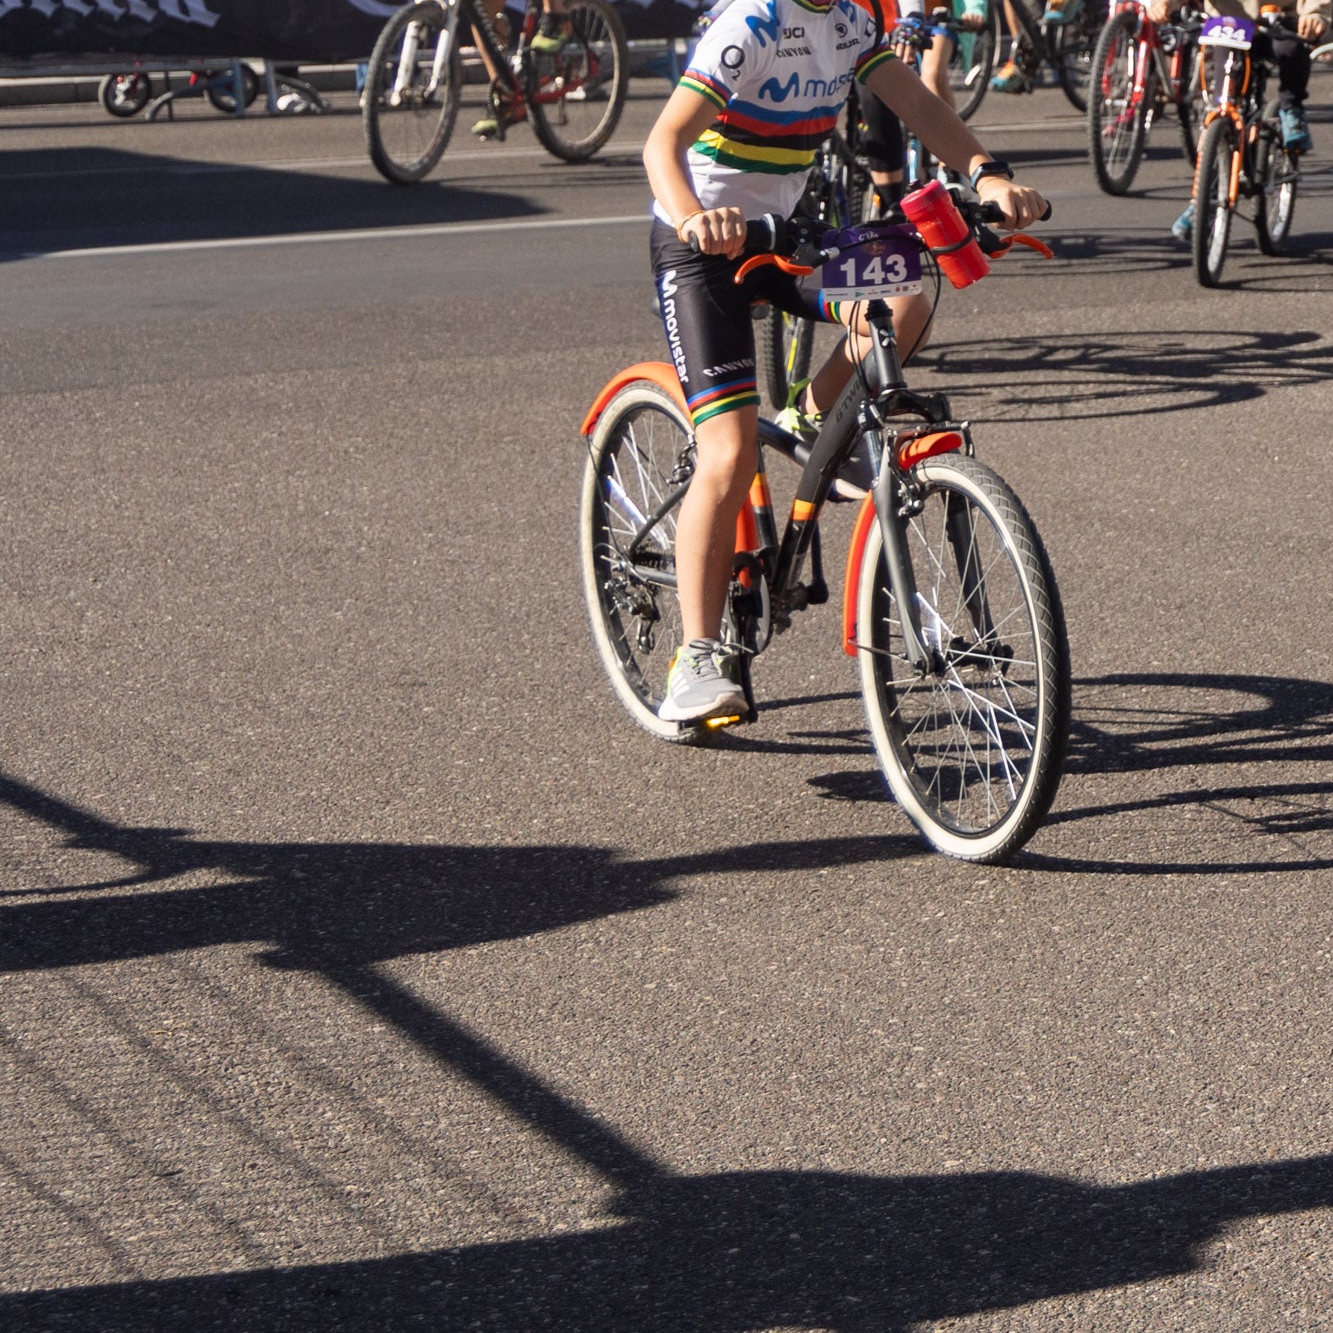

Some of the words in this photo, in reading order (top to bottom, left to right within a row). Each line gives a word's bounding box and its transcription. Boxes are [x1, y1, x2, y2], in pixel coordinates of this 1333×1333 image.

[1208, 25, 1246, 41] 434
[840, 254, 907, 287] 143
[662, 300, 689, 384] movistar
